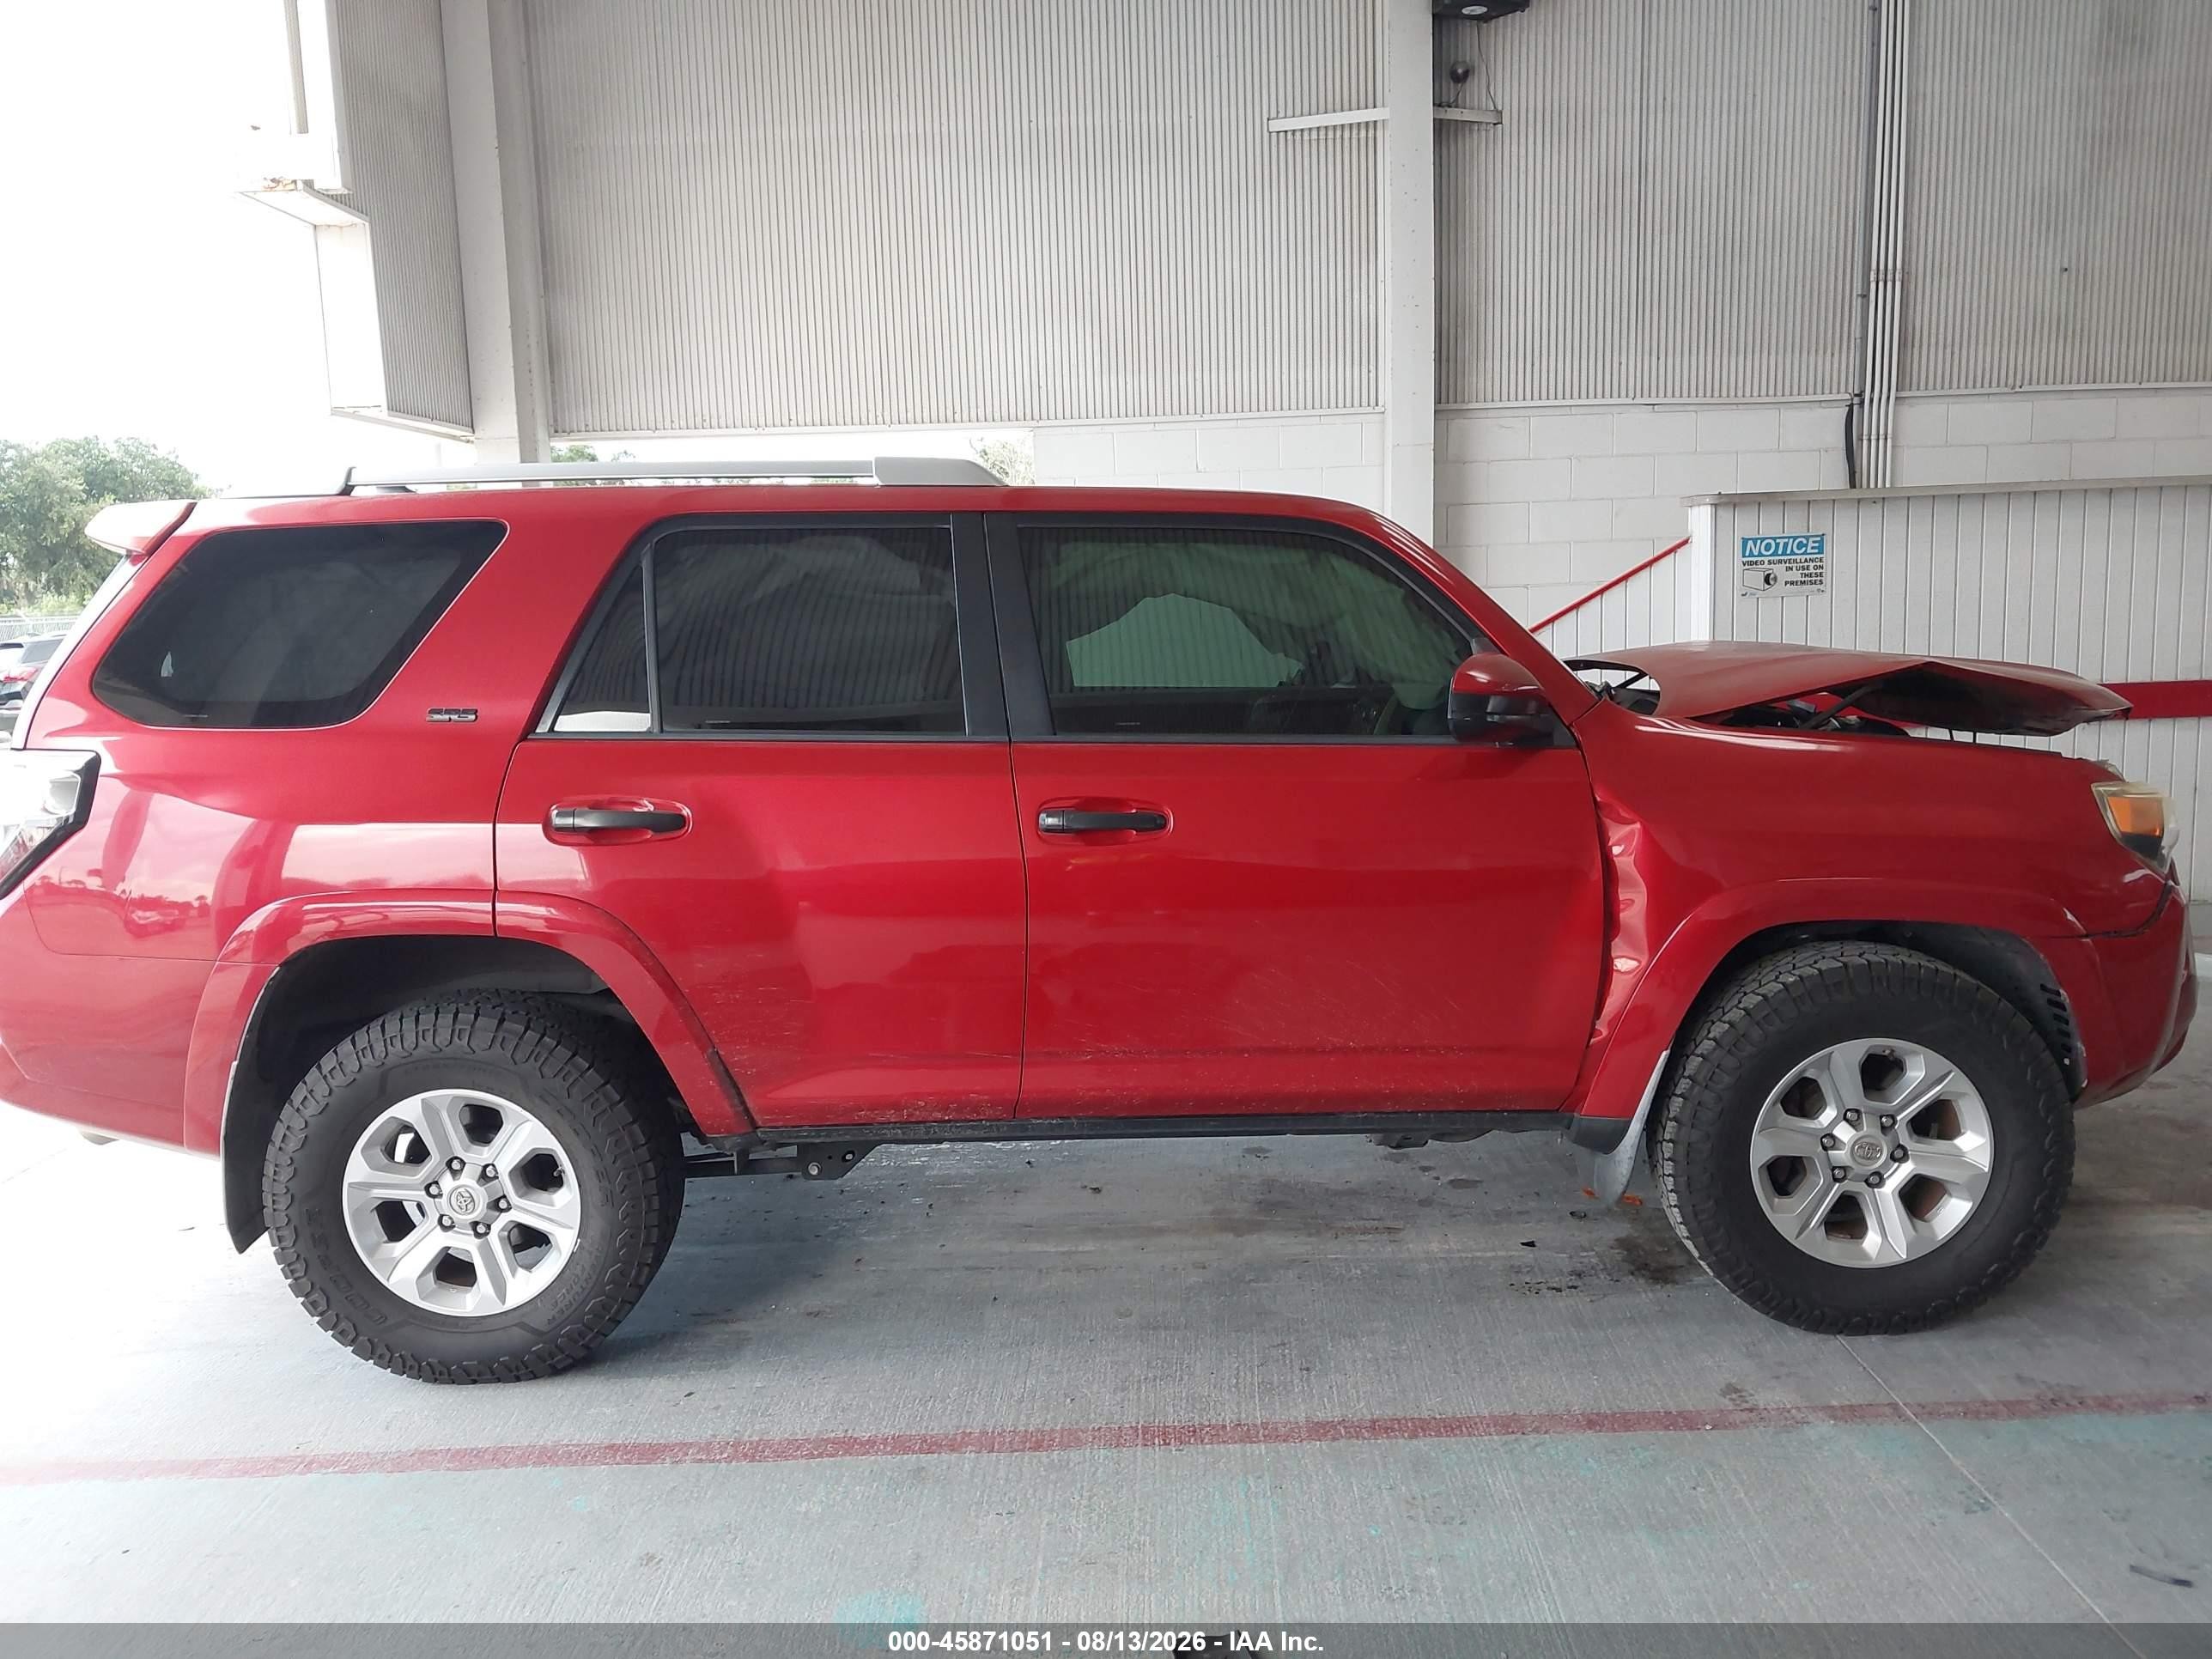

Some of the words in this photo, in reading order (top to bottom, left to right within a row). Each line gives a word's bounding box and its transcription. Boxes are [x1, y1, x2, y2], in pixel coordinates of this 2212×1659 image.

[1745, 537, 1821, 556] NOTICE
[1767, 556, 1824, 565] SURVEILLANCE
[427, 709, 478, 722] SR5
